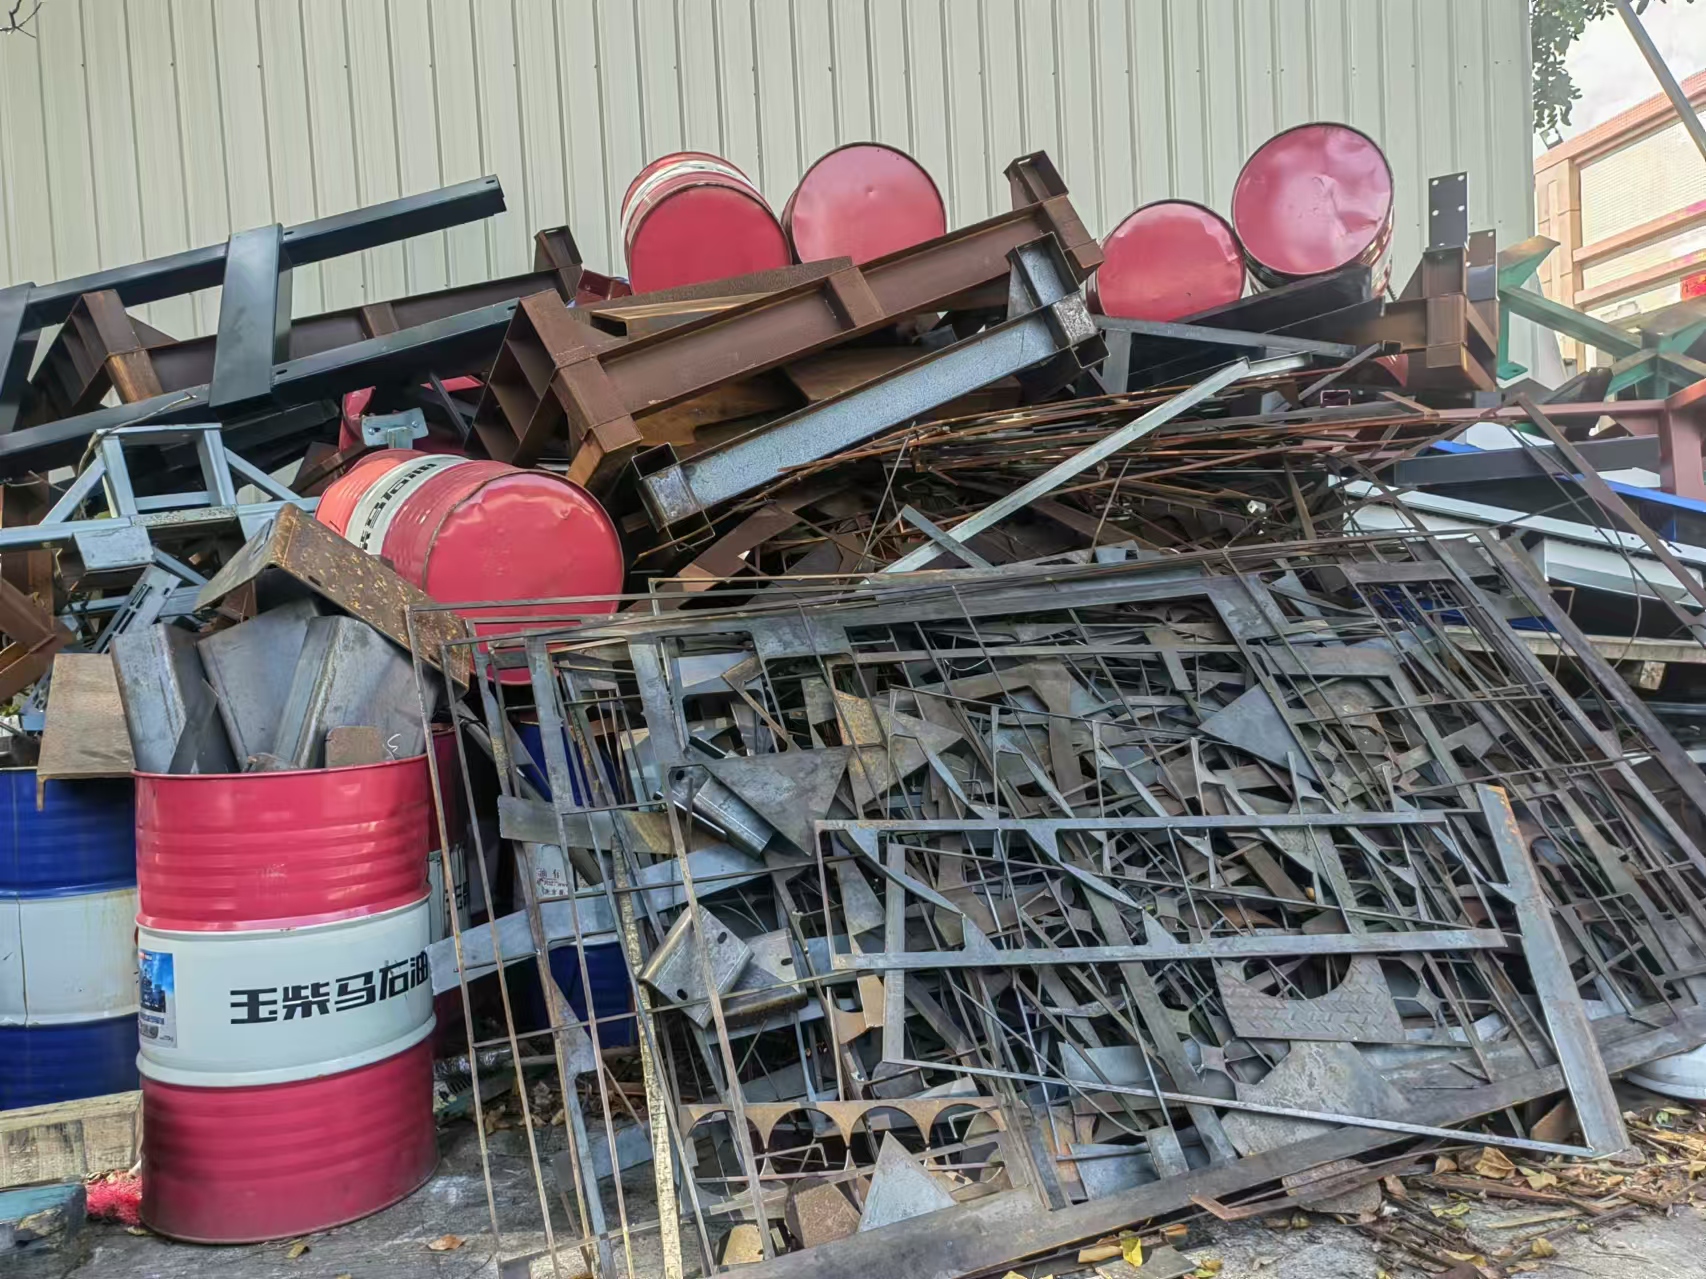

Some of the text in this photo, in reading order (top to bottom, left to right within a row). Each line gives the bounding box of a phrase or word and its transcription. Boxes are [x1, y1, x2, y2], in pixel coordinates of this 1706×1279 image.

[230, 951, 428, 1024] 玉柴马石油
